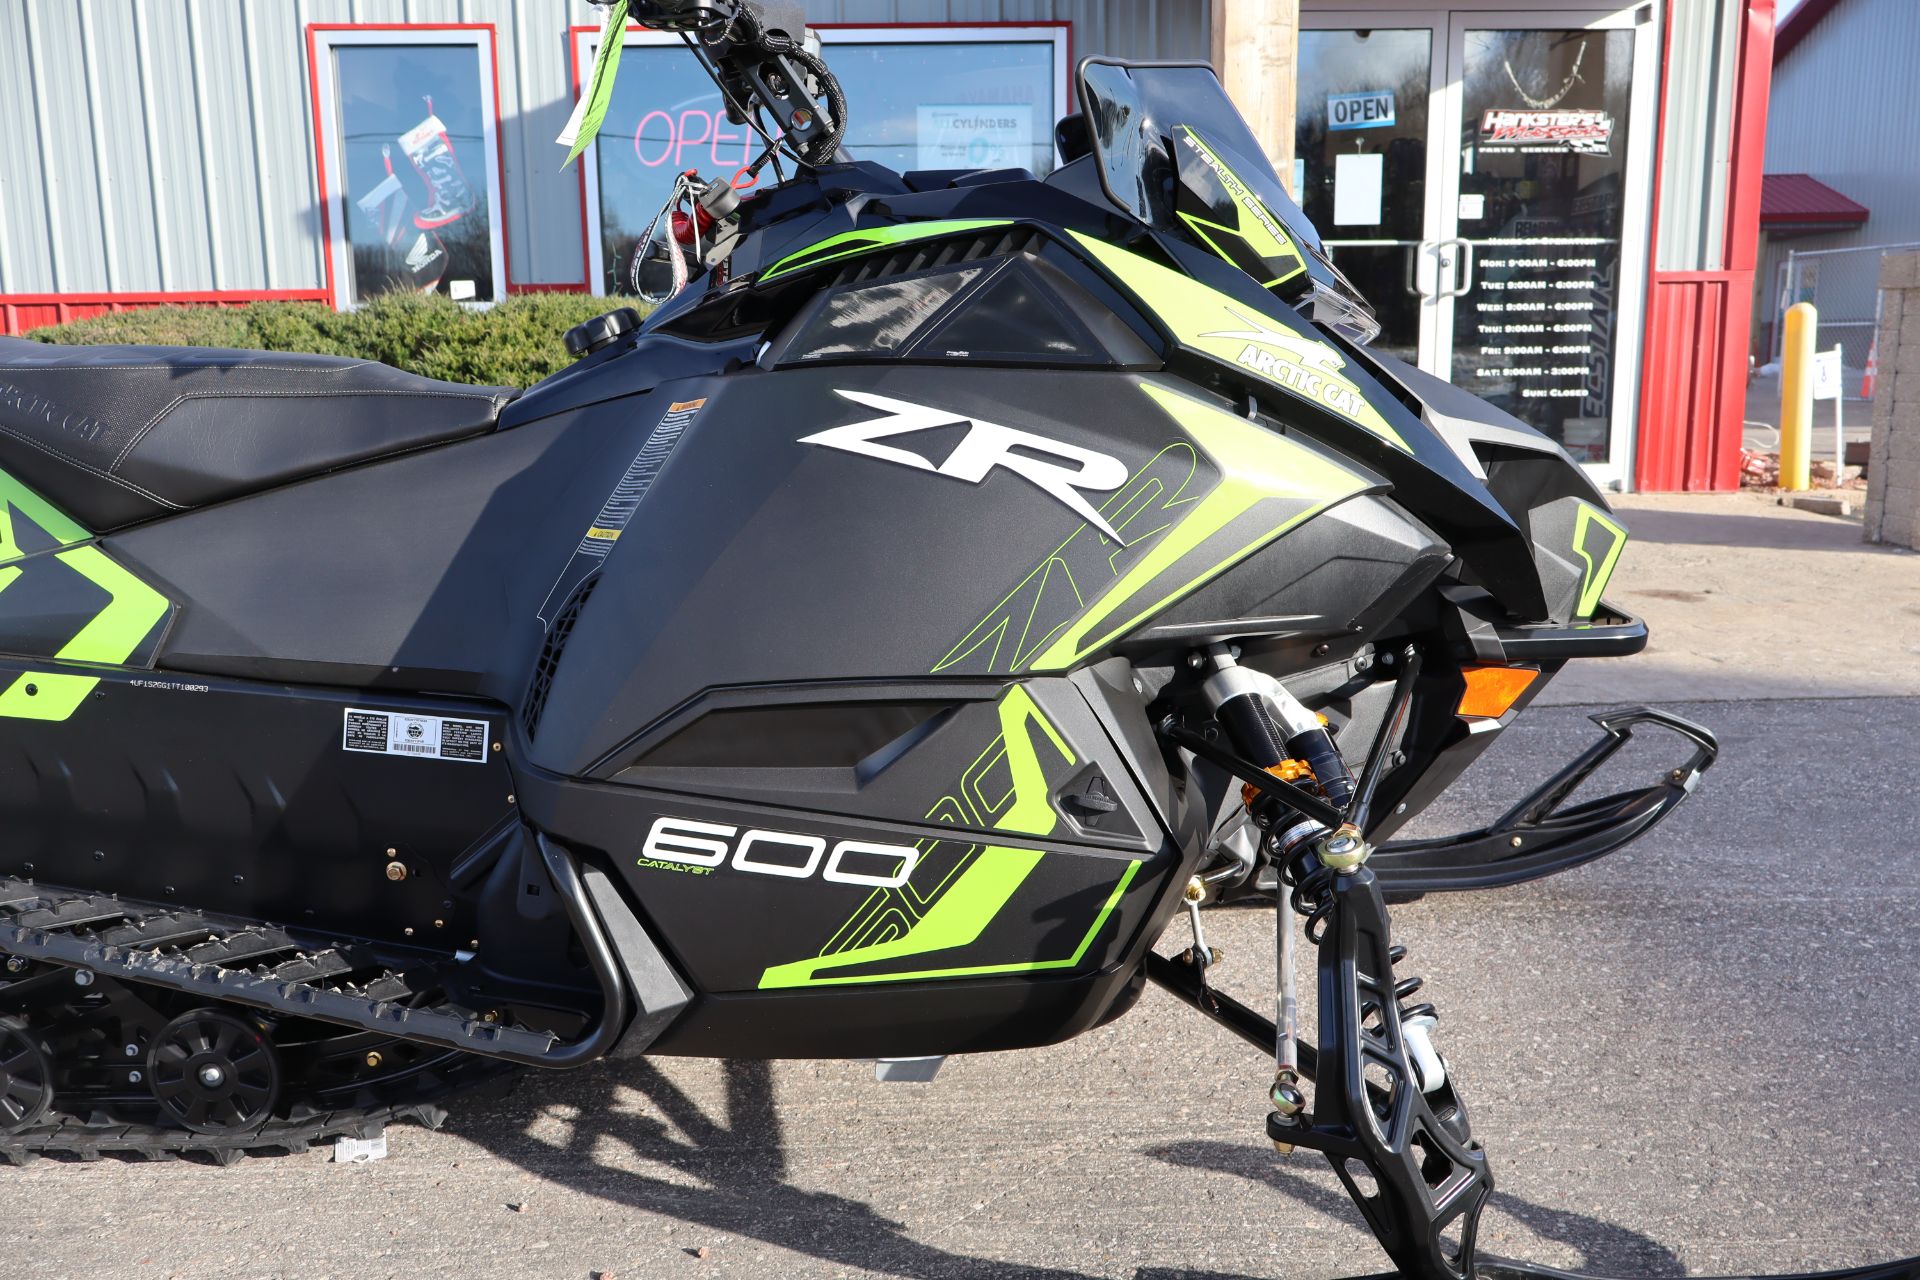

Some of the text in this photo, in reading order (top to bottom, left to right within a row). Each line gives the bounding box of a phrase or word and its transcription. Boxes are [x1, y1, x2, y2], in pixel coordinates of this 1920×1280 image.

[952, 116, 1017, 130] CYLINDERS
[1334, 98, 1388, 123] OPEN
[1183, 135, 1287, 246] STEALTH SERIES
[1239, 343, 1365, 417] ARCTIC CAT
[797, 389, 1129, 547] ZR
[637, 858, 714, 876] CATALYST
[642, 817, 920, 888] 600
